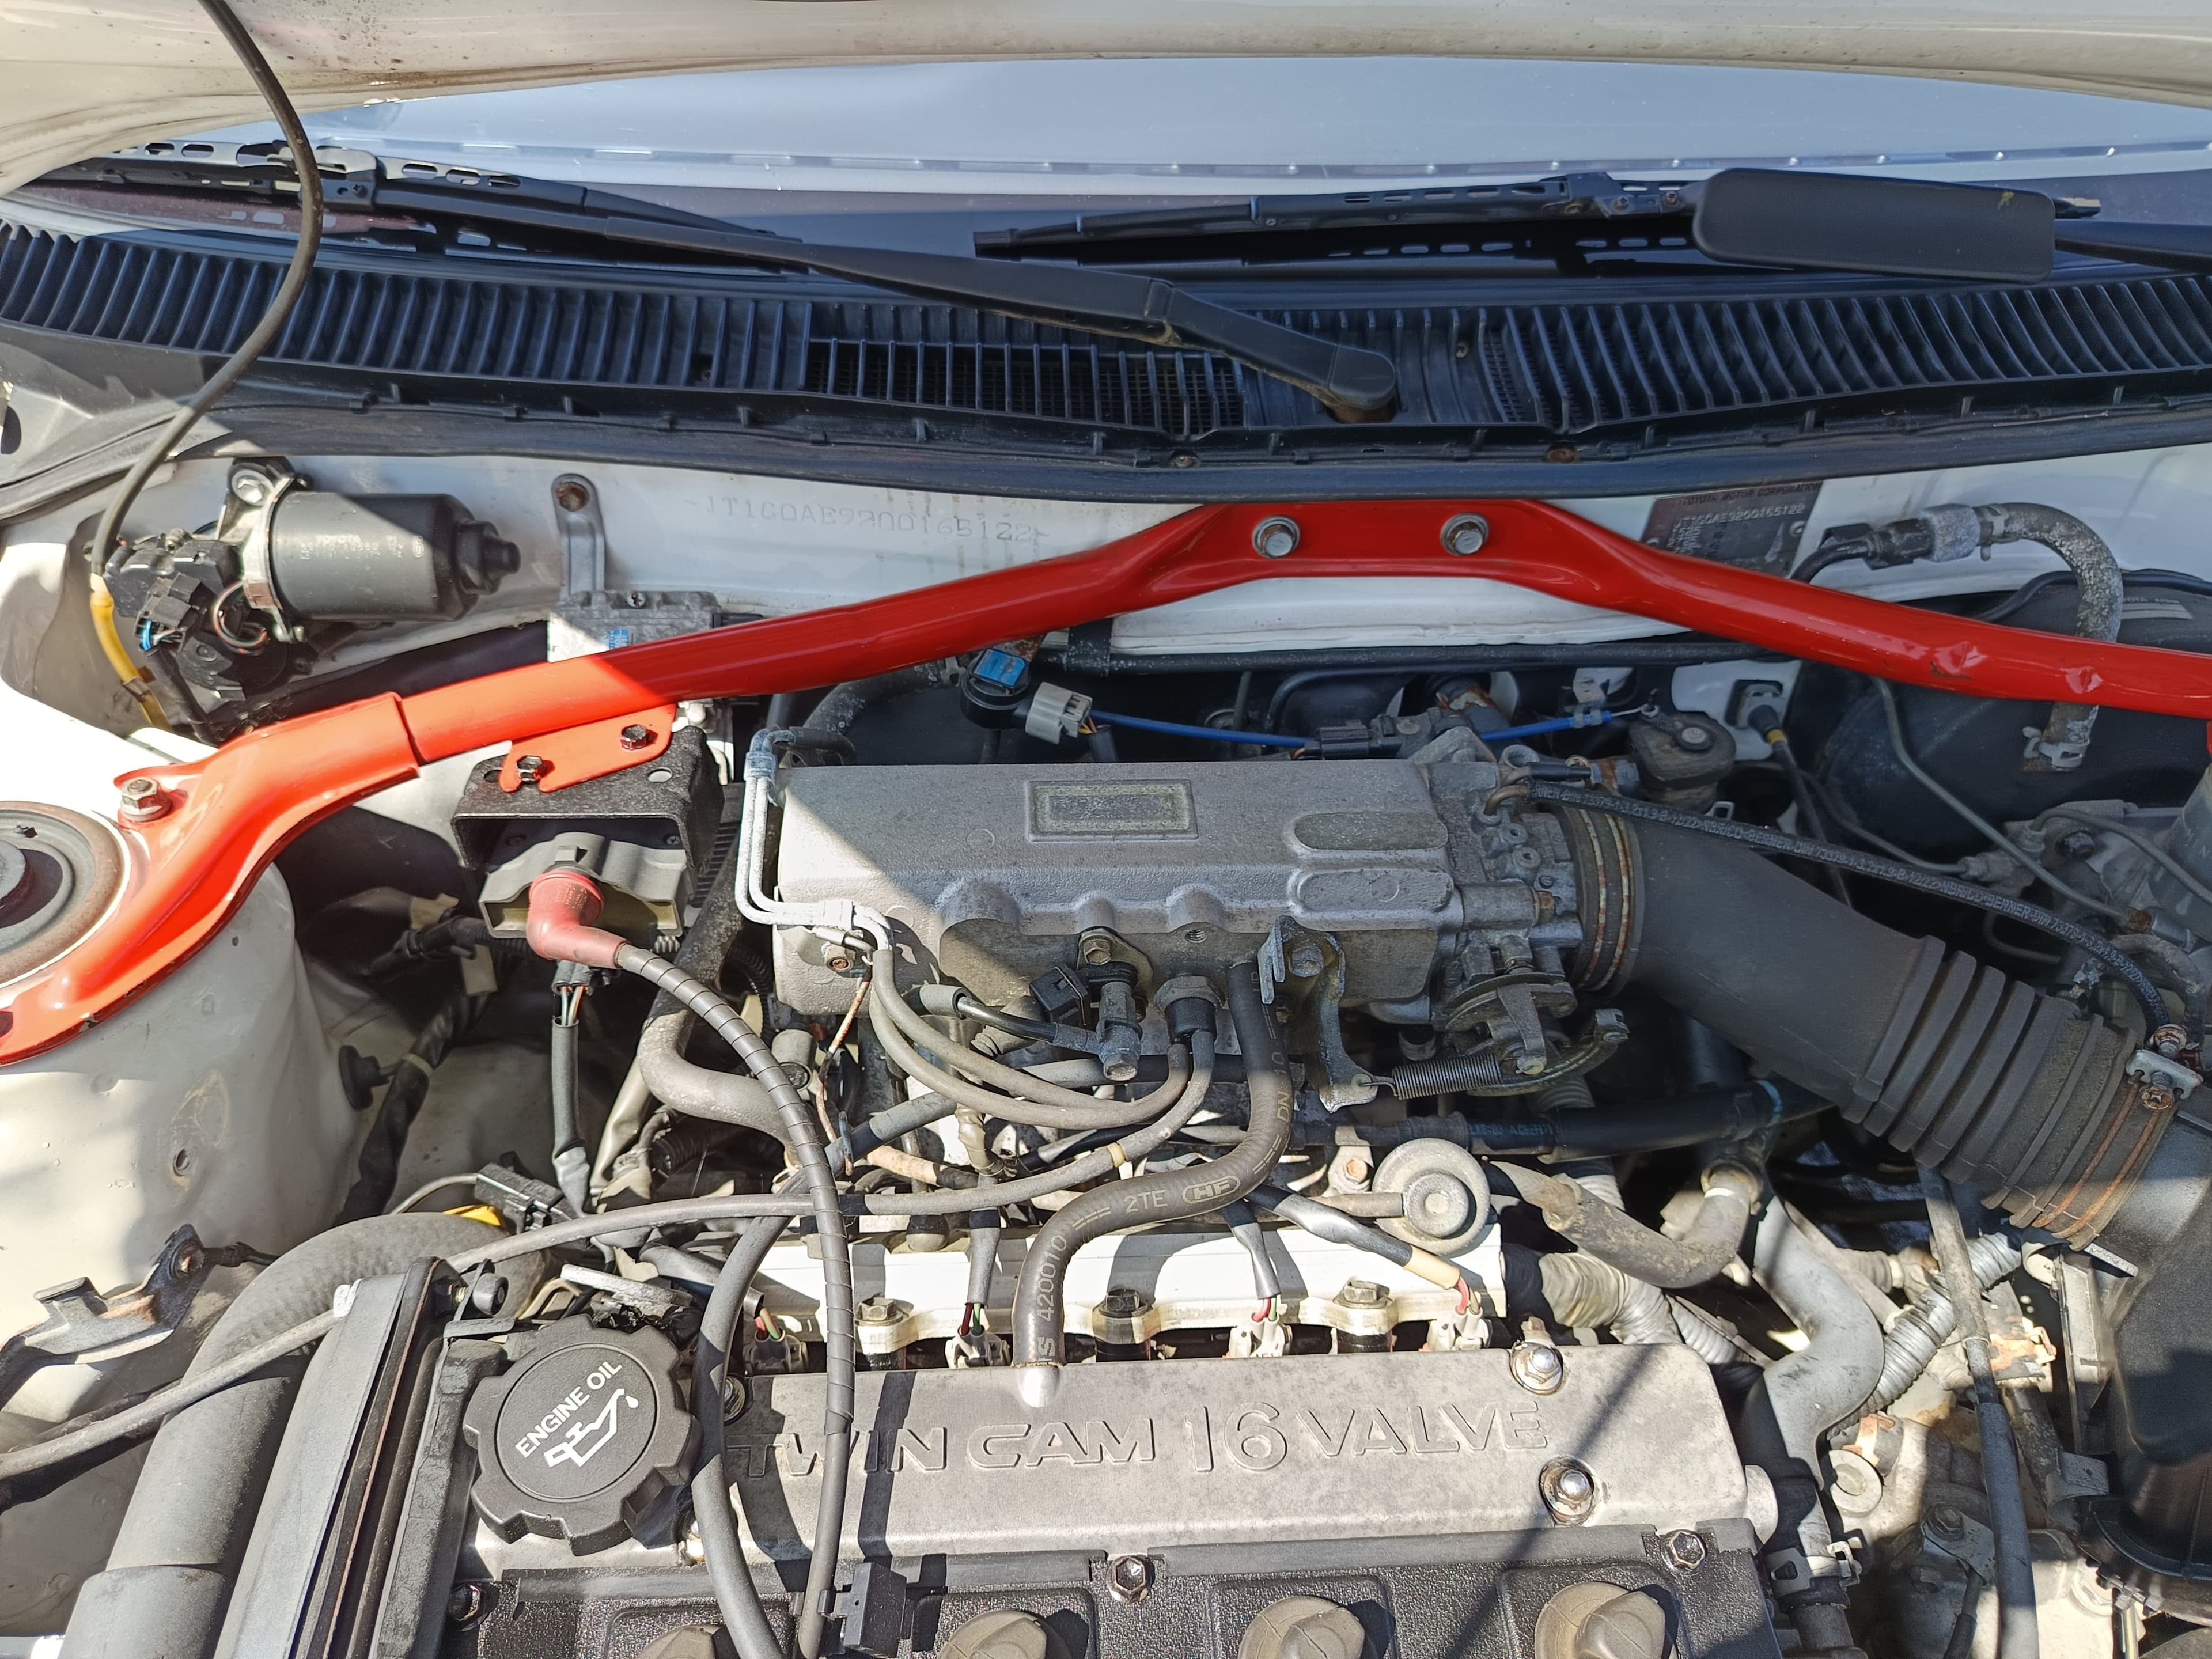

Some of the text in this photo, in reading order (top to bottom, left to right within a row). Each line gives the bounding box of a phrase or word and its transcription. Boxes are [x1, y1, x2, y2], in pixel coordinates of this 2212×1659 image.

[1036, 1234, 1068, 1322] 420010
[1123, 1189, 1167, 1214] 2TE
[1276, 1090, 1291, 1123] DN
[514, 1361, 623, 1459] ENGINE OIL
[726, 1400, 1548, 1478] TWIN CAM 16 VALVE
